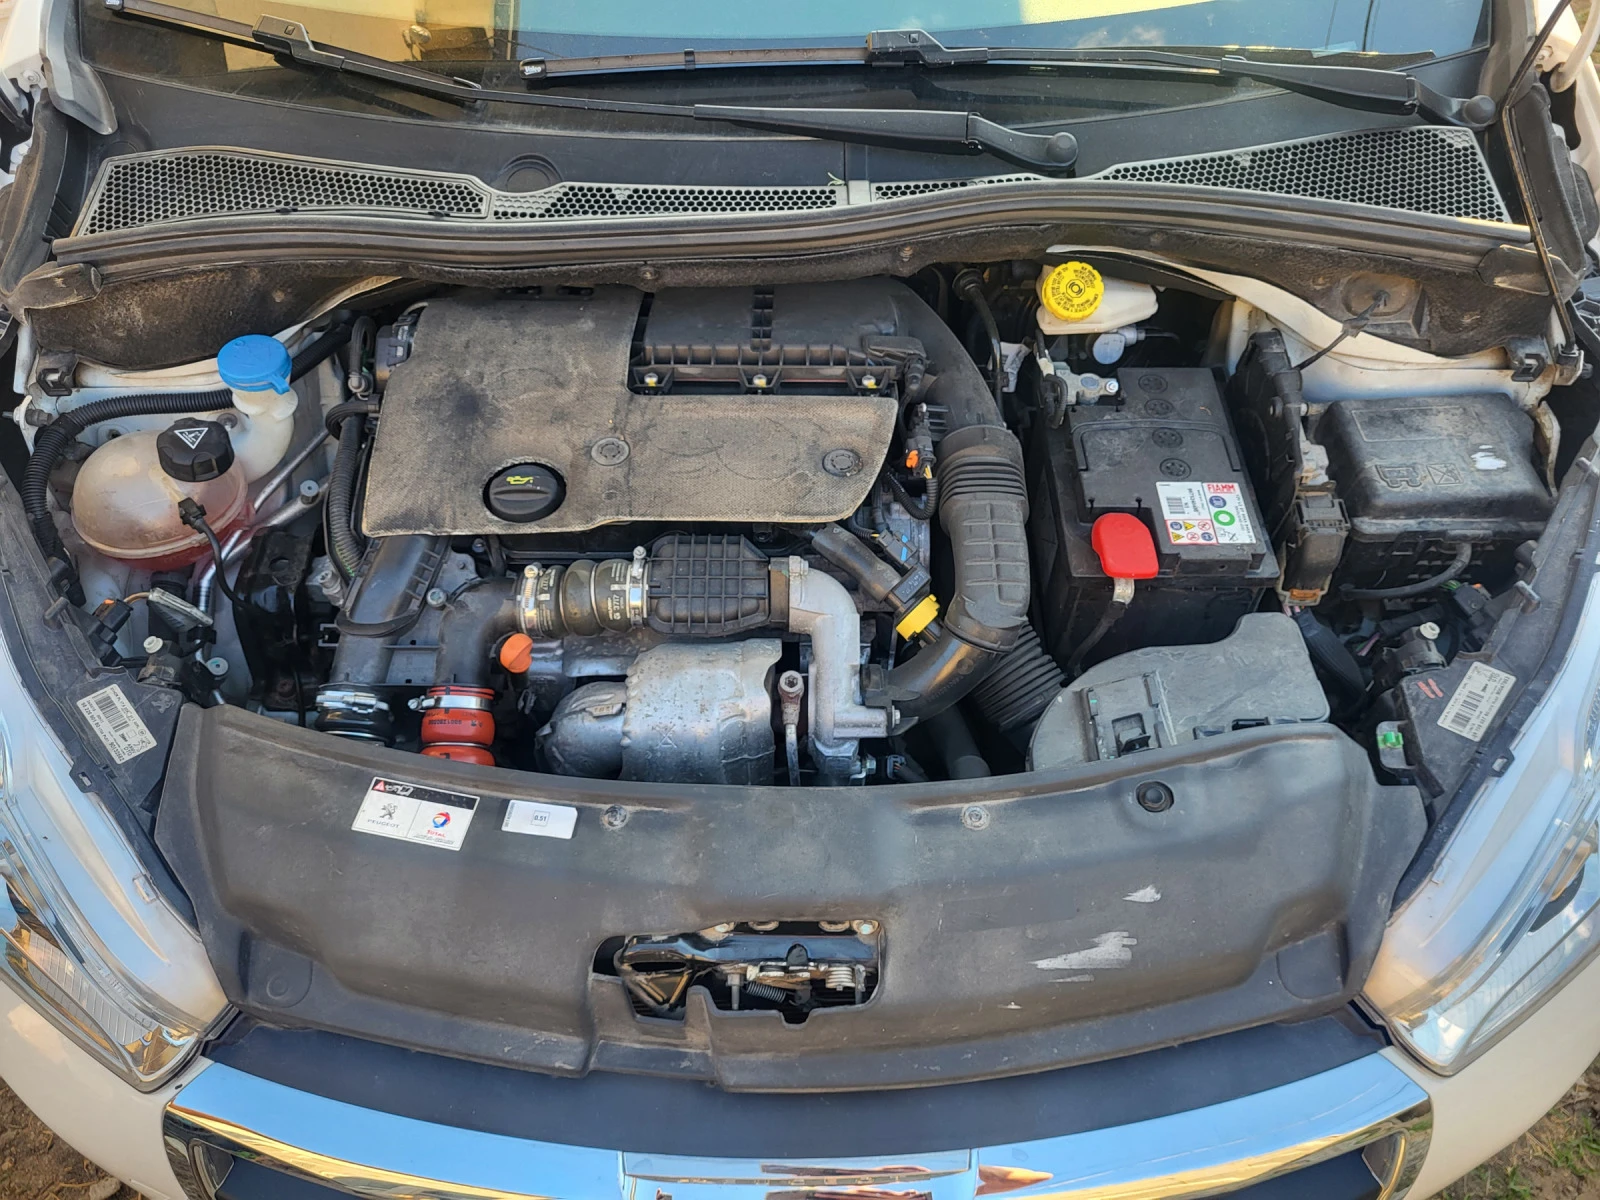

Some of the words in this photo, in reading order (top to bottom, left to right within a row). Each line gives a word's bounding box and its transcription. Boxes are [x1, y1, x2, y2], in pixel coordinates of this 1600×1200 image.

[1207, 484, 1235, 492] FIAMM
[367, 818, 400, 829] PEUGEOT
[427, 829, 446, 838] TOTAL
